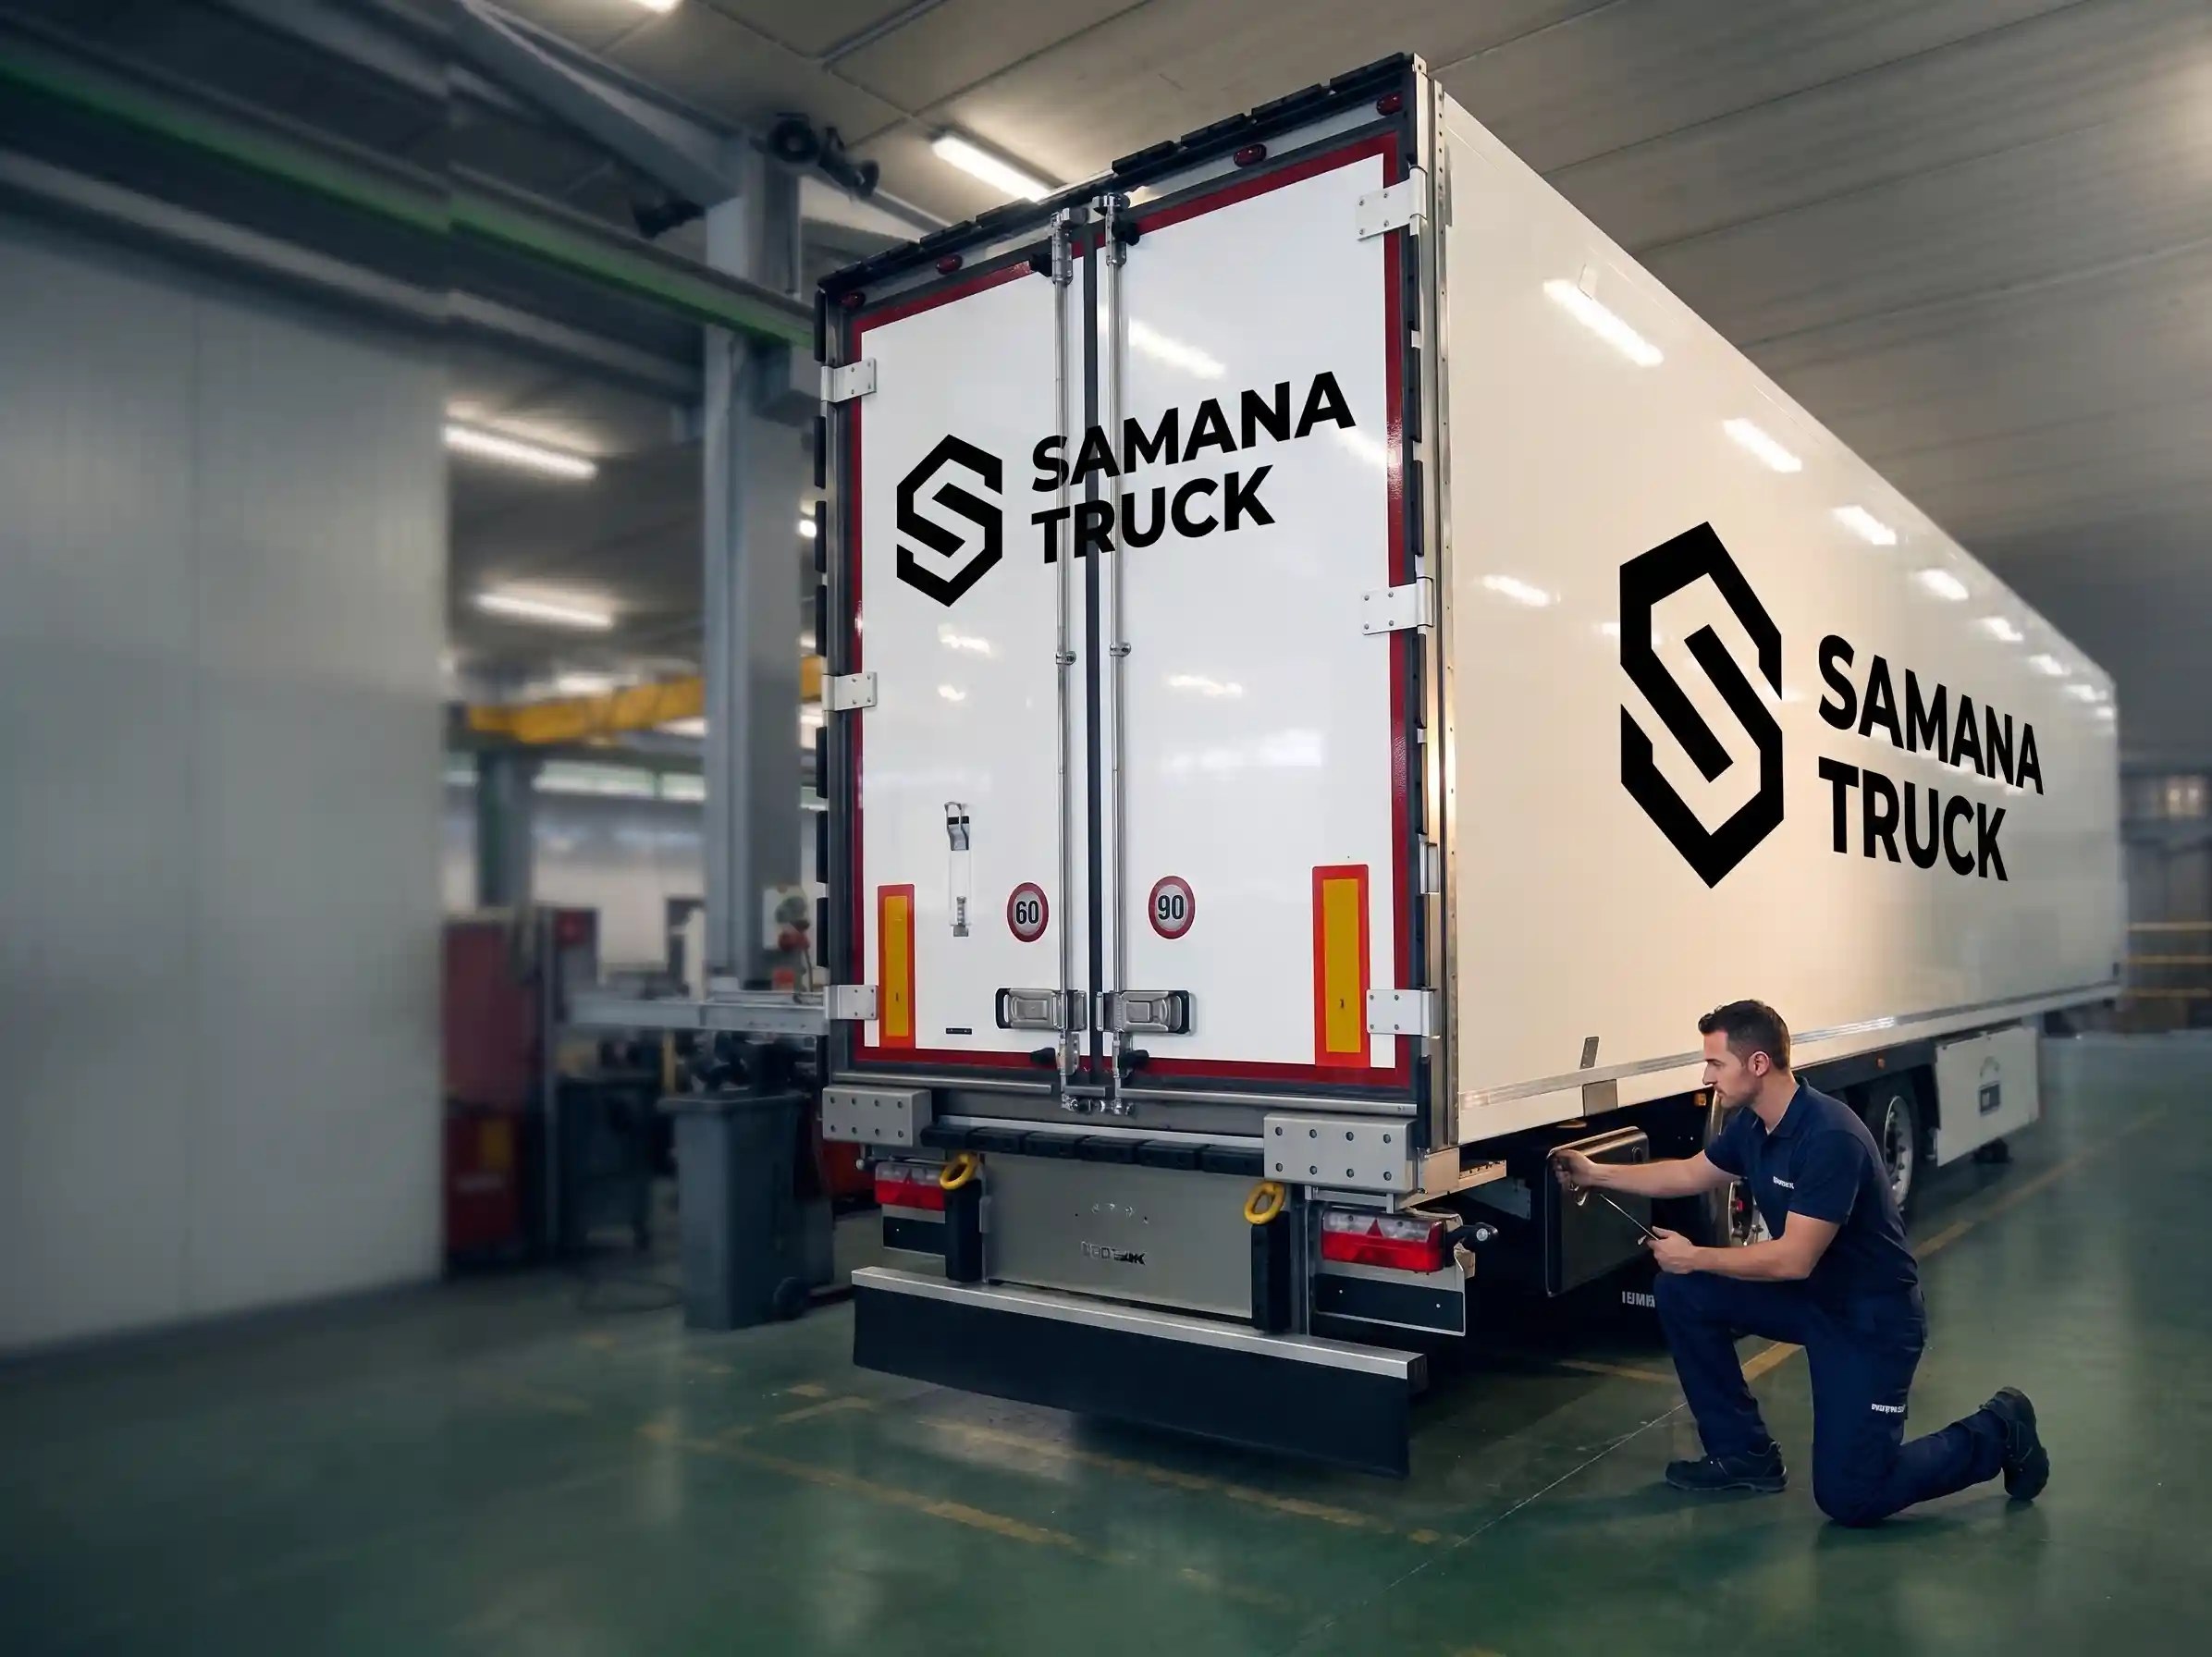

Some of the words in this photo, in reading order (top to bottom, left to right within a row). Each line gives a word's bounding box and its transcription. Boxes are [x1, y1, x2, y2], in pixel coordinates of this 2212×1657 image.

[1031, 371, 1357, 493] SAMANA
[1031, 464, 1275, 564] TRUCK
[1818, 634, 2045, 796] SAMANA
[1818, 755, 2009, 882] TRUCK
[1015, 900, 1039, 925] 60
[1158, 894, 1185, 920] 90
